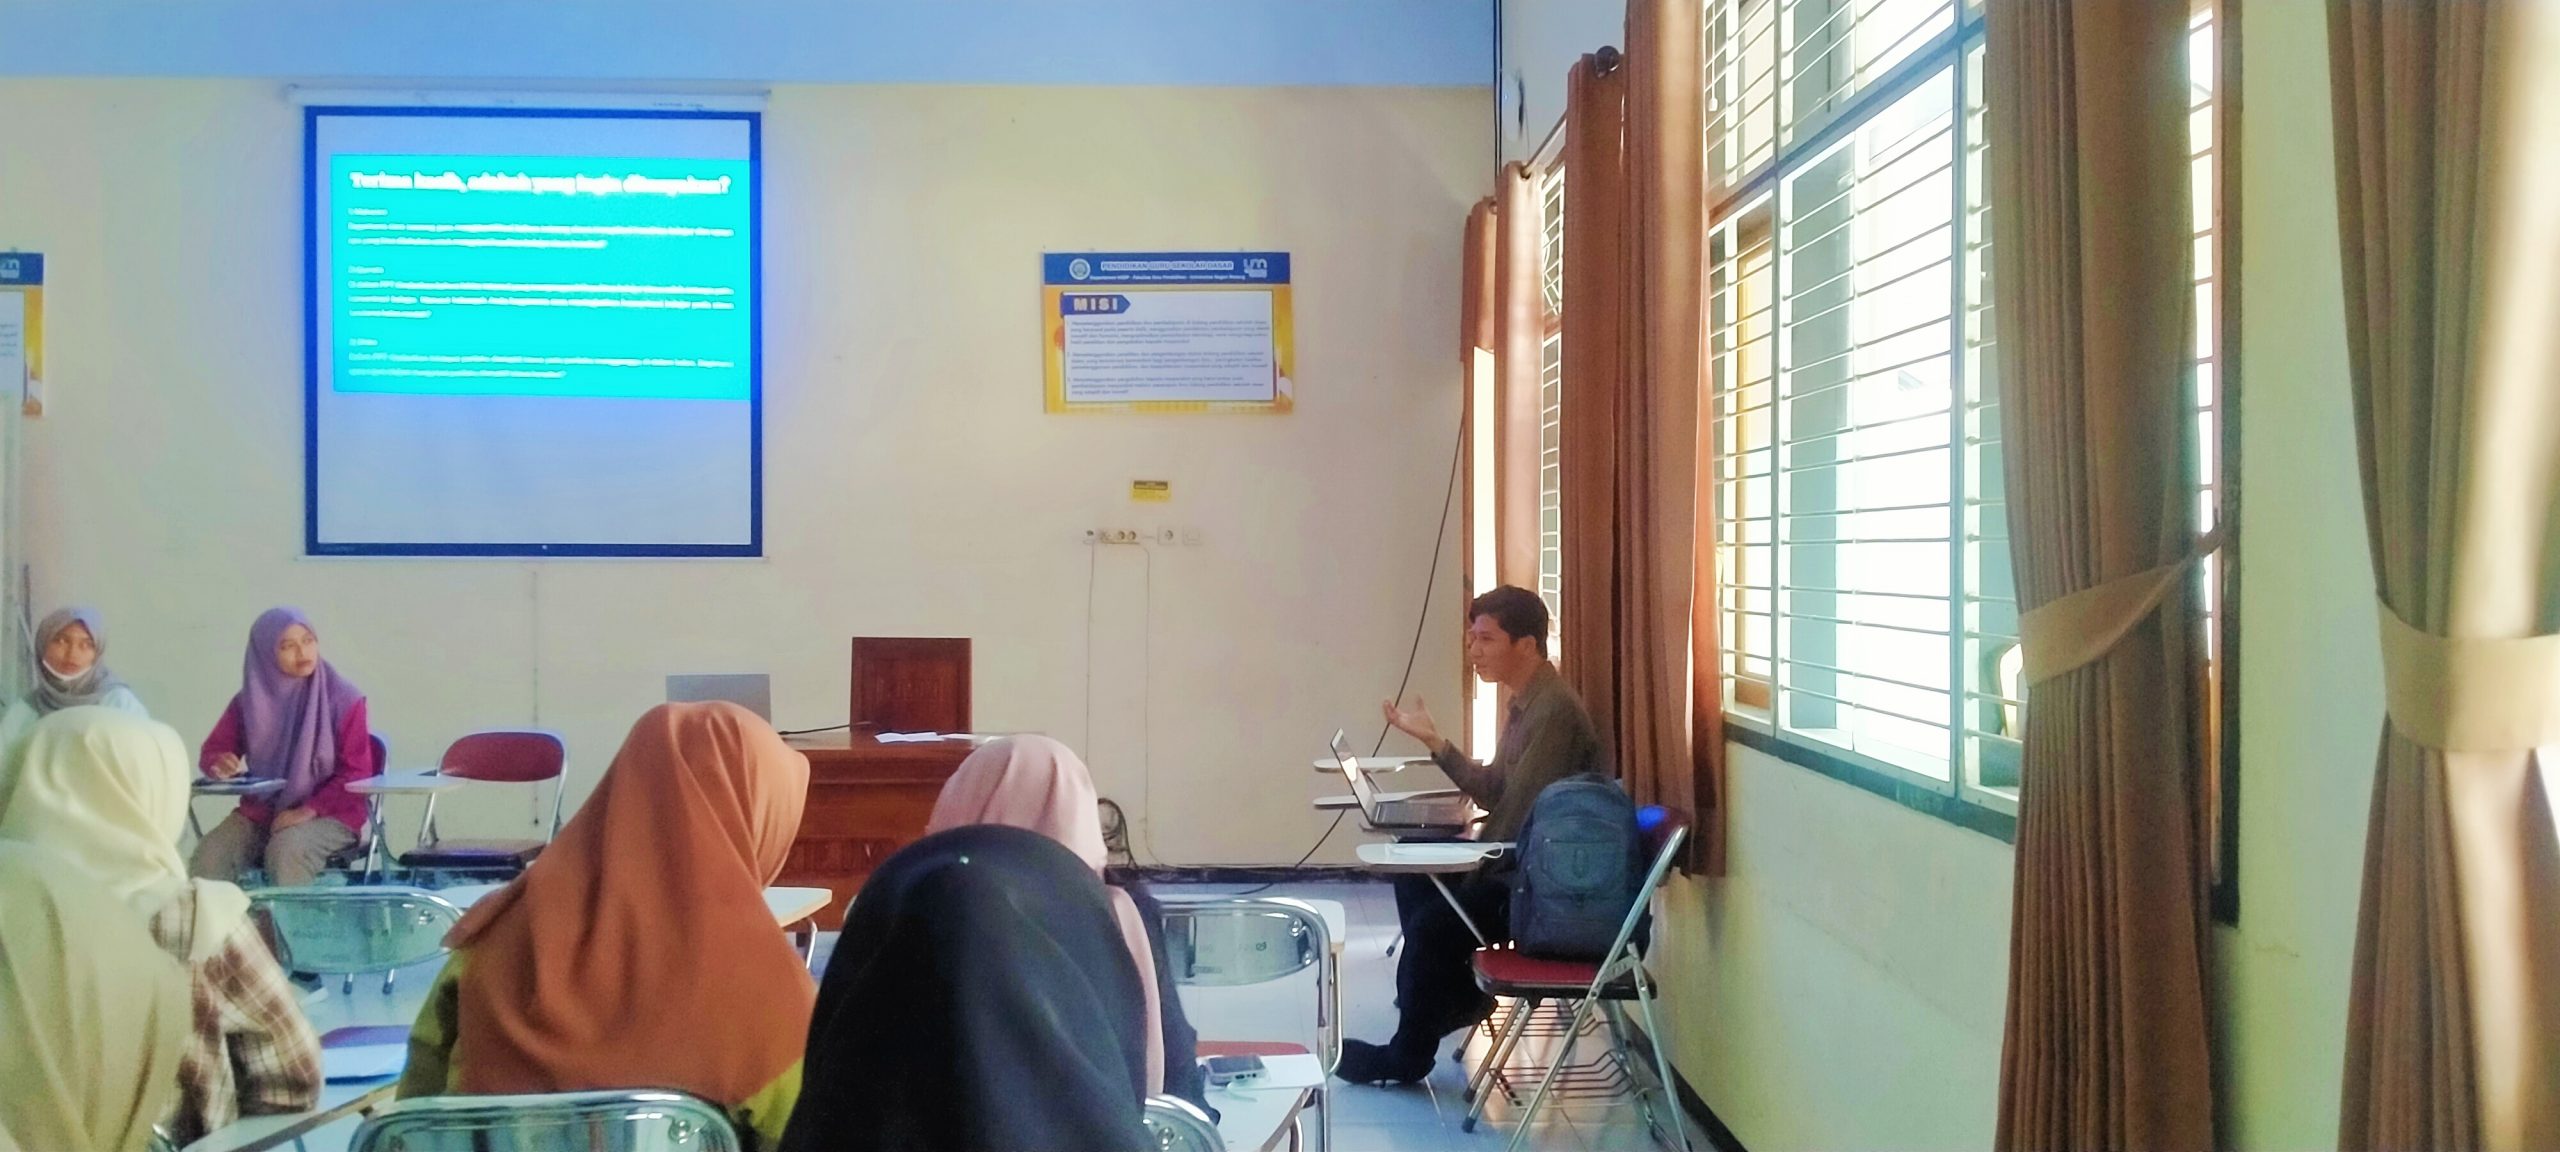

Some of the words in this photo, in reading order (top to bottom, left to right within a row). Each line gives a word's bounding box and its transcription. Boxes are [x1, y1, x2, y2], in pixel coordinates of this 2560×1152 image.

[1102, 262, 1148, 270] PENDIDIKAN
[1149, 262, 1169, 270] GURU
[1171, 262, 1206, 270] SEKOLAH
[1207, 261, 1233, 269] DASAR
[1073, 297, 1118, 311] MISI
